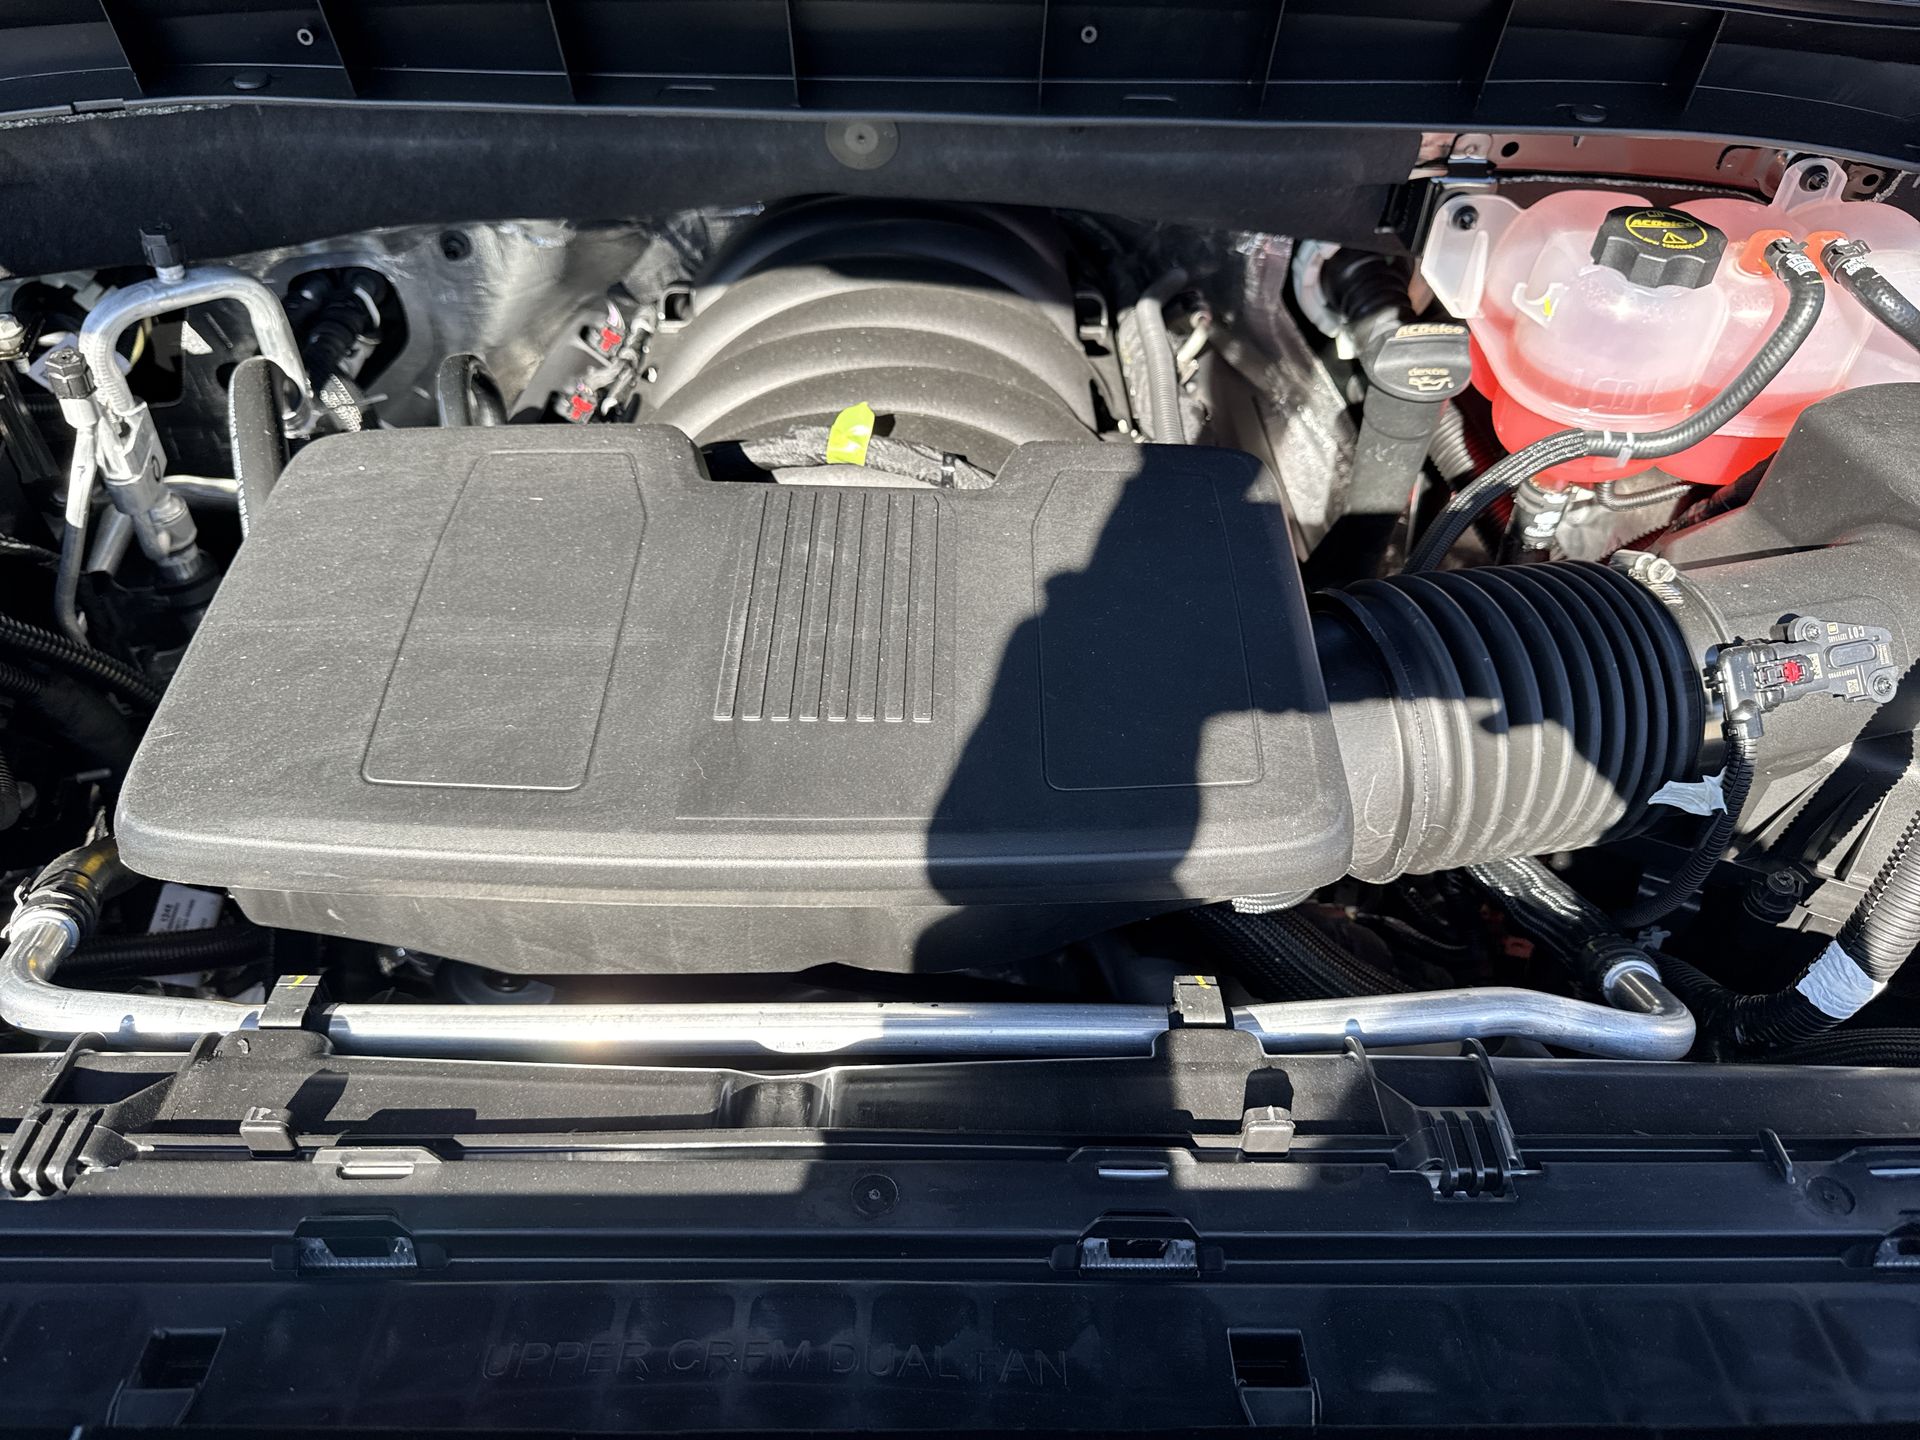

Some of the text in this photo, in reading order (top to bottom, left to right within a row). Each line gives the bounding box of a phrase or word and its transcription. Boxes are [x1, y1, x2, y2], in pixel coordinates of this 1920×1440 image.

[1629, 218, 1695, 229] ACDelco
[1395, 323, 1466, 339] ACDelco
[1407, 366, 1450, 376] dexos
[482, 1339, 651, 1378] UPPER
[668, 1338, 811, 1373] CRFM
[829, 1340, 961, 1378] DUAL
